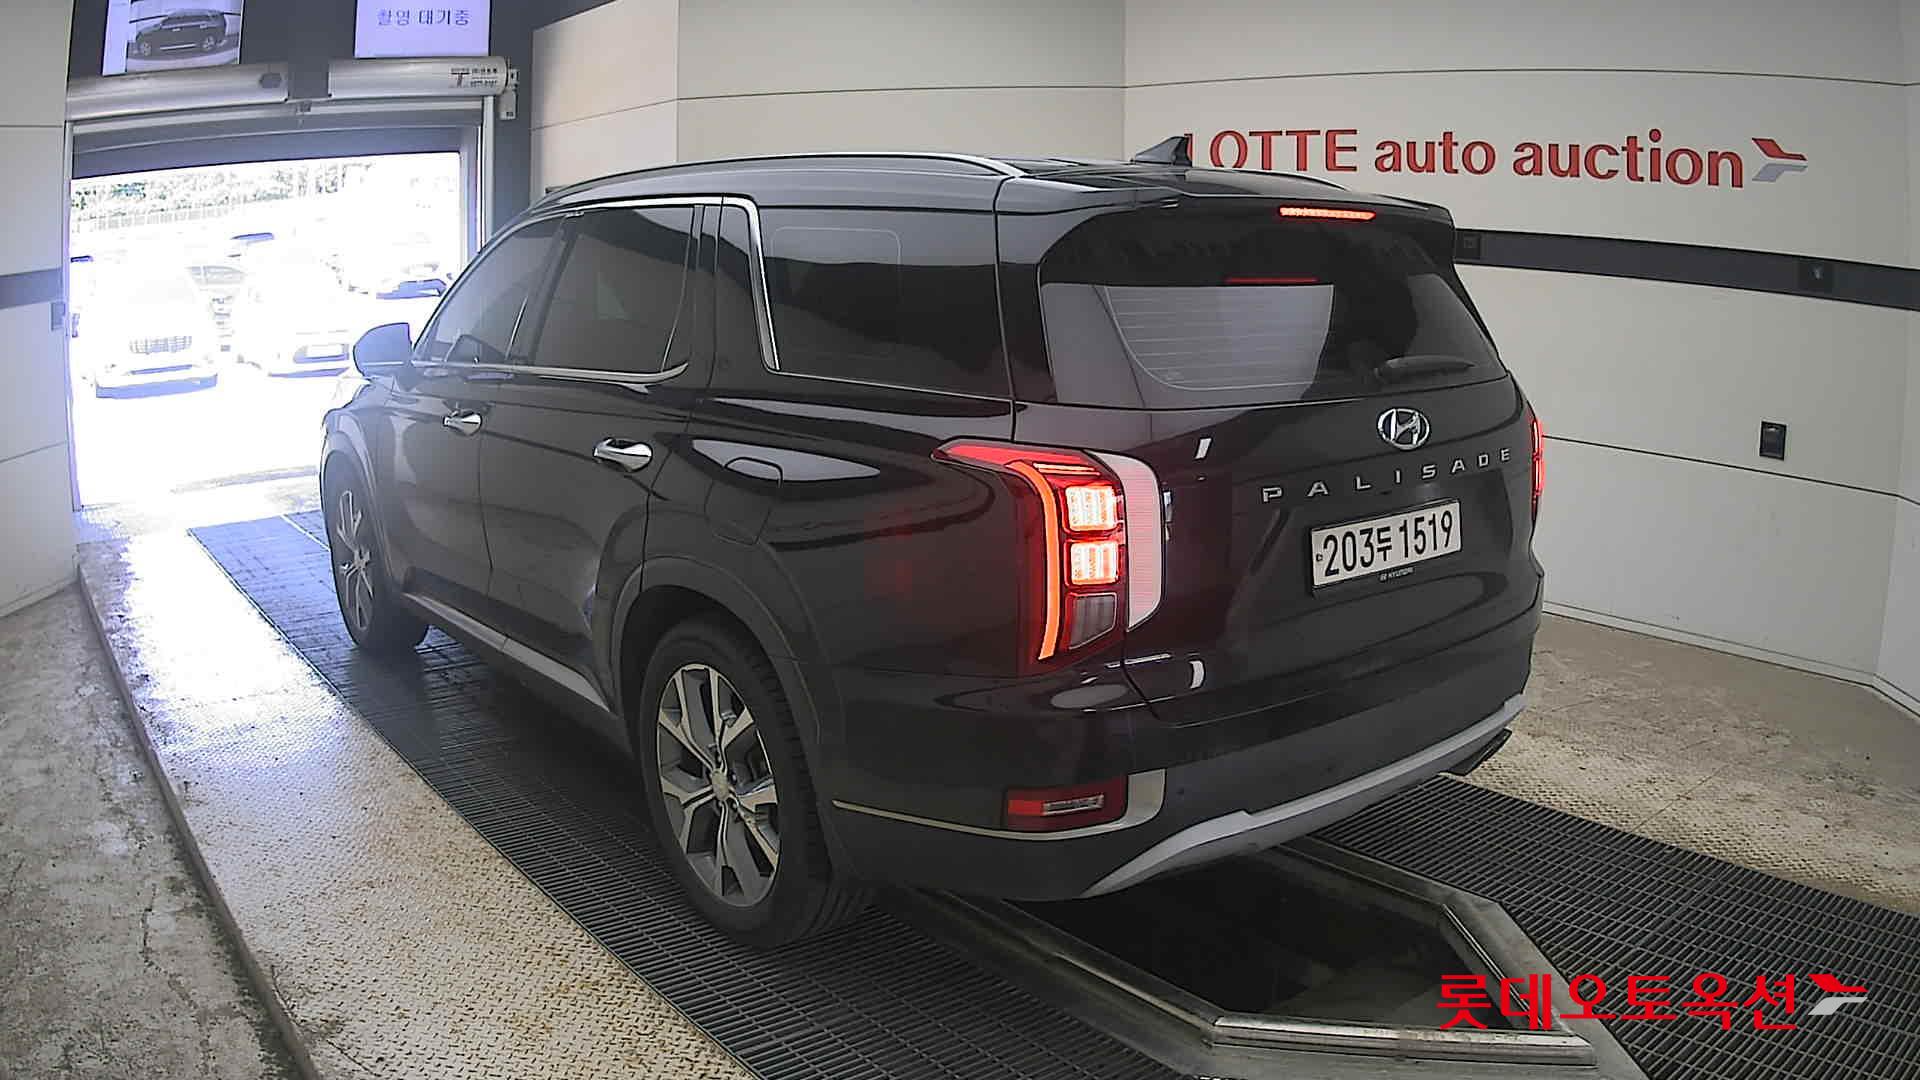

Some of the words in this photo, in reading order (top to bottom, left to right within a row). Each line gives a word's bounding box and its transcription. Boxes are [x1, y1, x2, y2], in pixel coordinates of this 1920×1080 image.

[418, 8, 471, 26] 대기중
[1374, 130, 1497, 177] auto
[1512, 127, 1745, 189] auction
[1262, 447, 1511, 503] PALISADE
[1399, 510, 1453, 559] 1519
